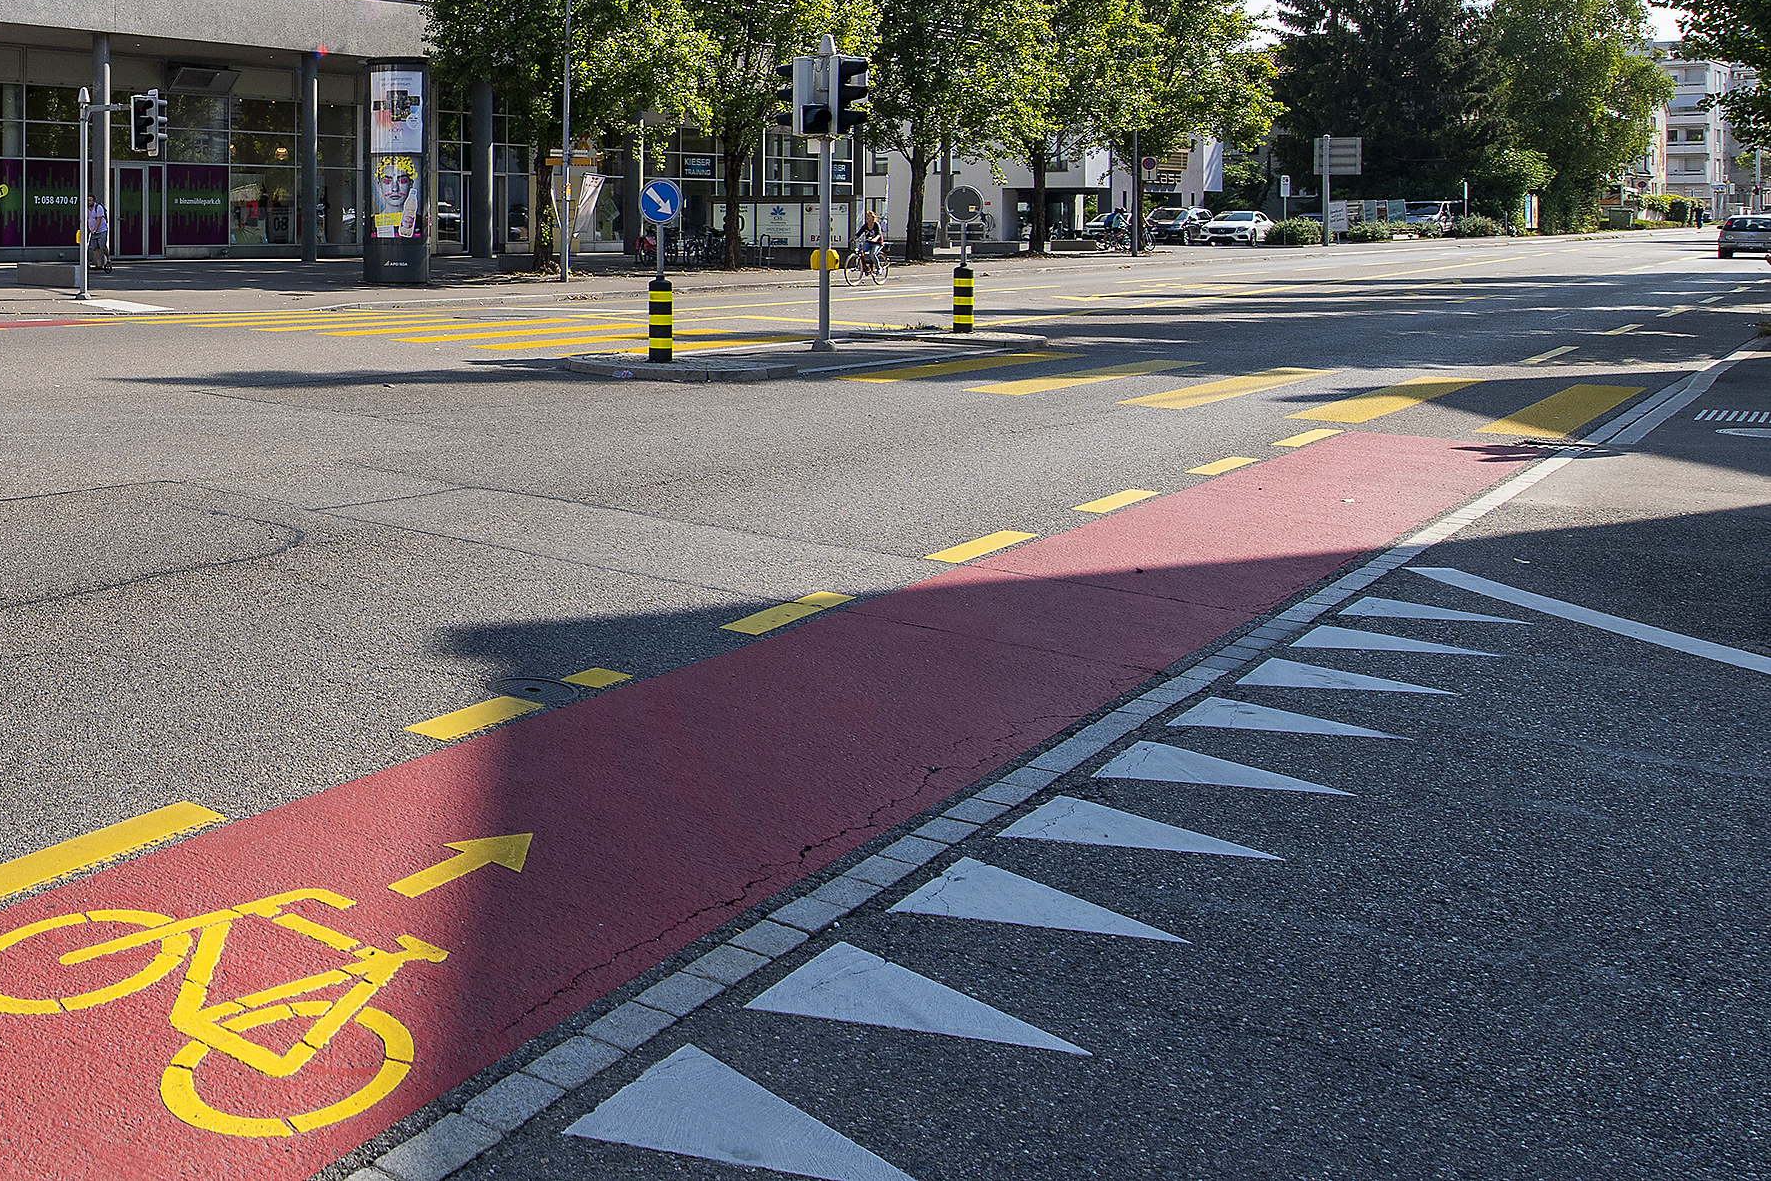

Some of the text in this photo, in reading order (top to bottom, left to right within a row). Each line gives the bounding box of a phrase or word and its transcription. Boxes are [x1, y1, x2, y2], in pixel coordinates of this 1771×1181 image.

[684, 157, 711, 167] KIESER
[684, 168, 711, 176] TRAINING
[41, 196, 55, 205] 058
[55, 196, 69, 206] 470
[69, 196, 78, 206] 47
